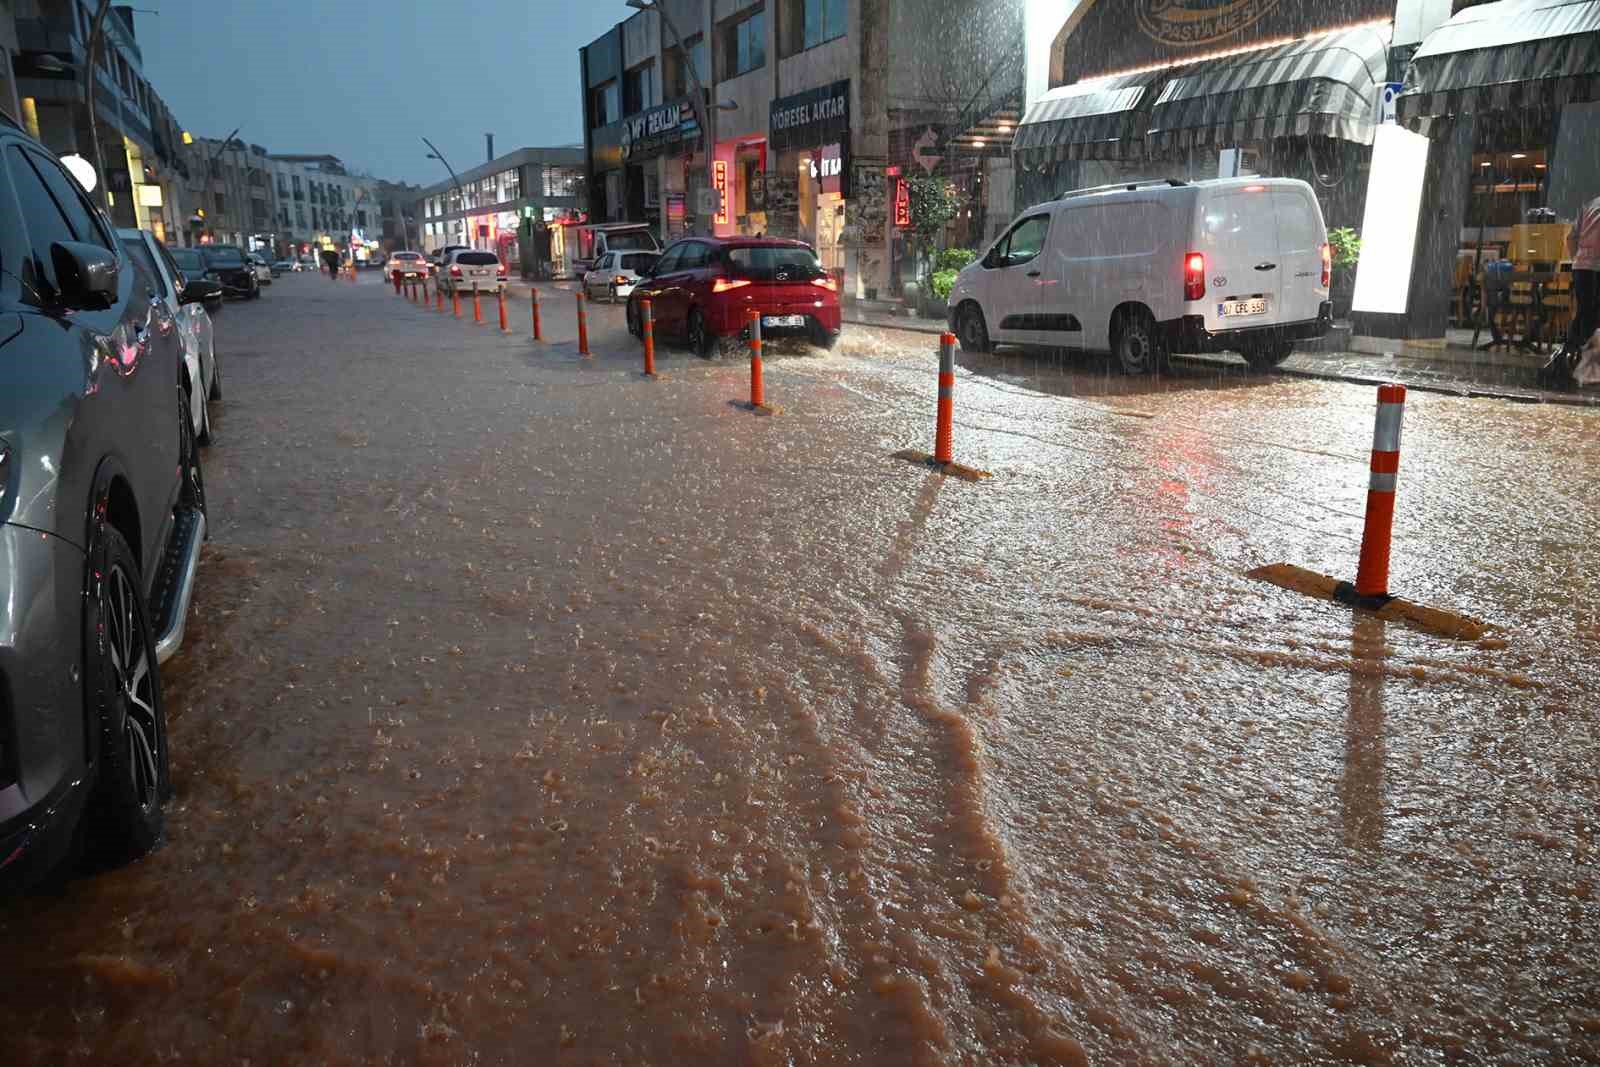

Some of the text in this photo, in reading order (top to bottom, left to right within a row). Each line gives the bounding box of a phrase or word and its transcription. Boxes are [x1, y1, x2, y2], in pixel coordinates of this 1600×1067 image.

[648, 105, 680, 136] REKLAM
[770, 95, 845, 130] YÖRESEL AKTAR
